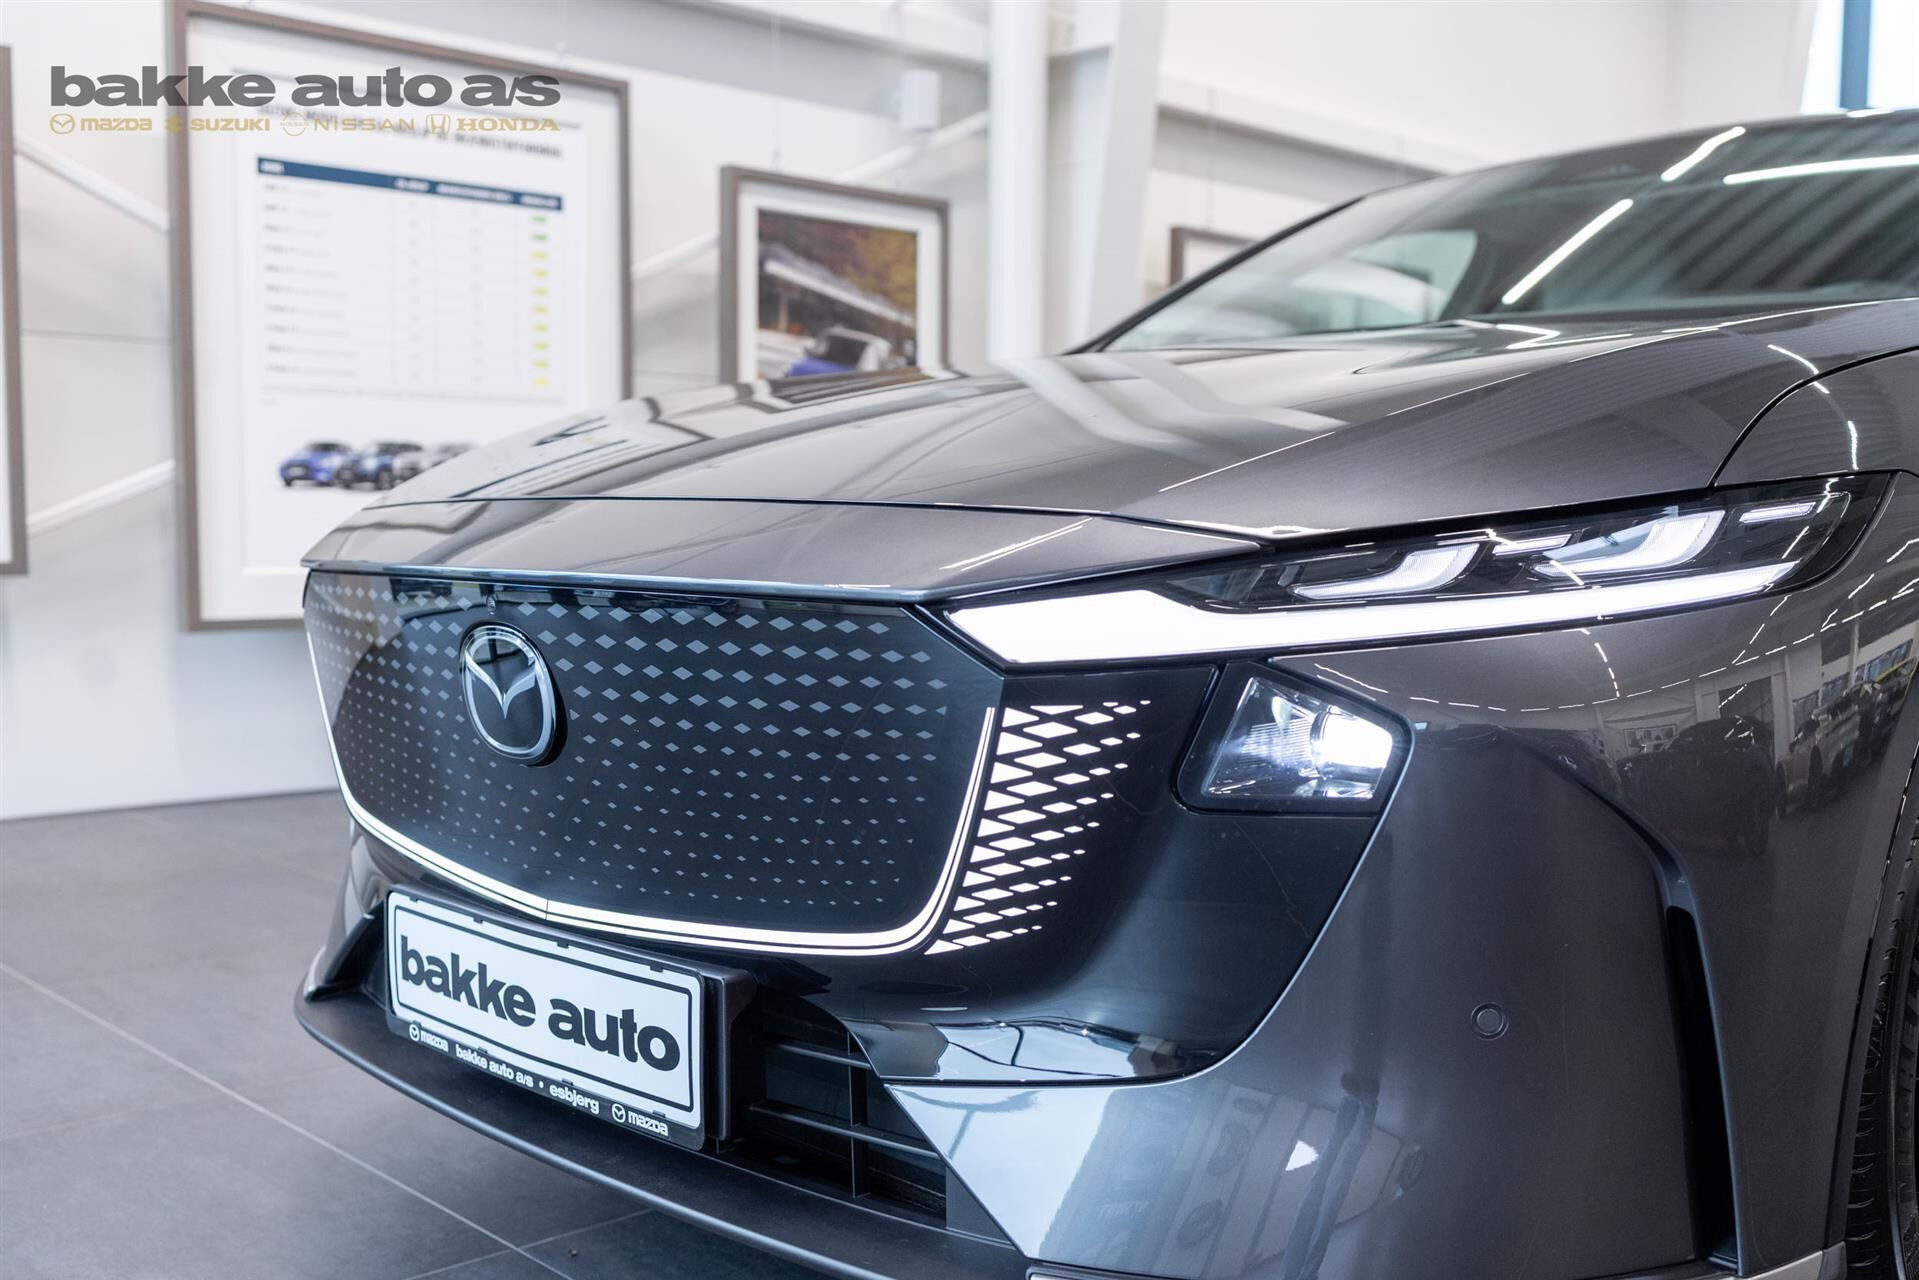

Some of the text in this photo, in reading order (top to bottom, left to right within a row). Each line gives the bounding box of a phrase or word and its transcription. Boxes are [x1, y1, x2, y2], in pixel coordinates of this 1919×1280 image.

[401, 935, 681, 1071] bakke auto
[456, 1044, 488, 1070] bakke
[489, 1059, 514, 1081] auto
[516, 1071, 534, 1088] a/s
[549, 1084, 599, 1114] esbjerg
[628, 1112, 669, 1136] mazda
